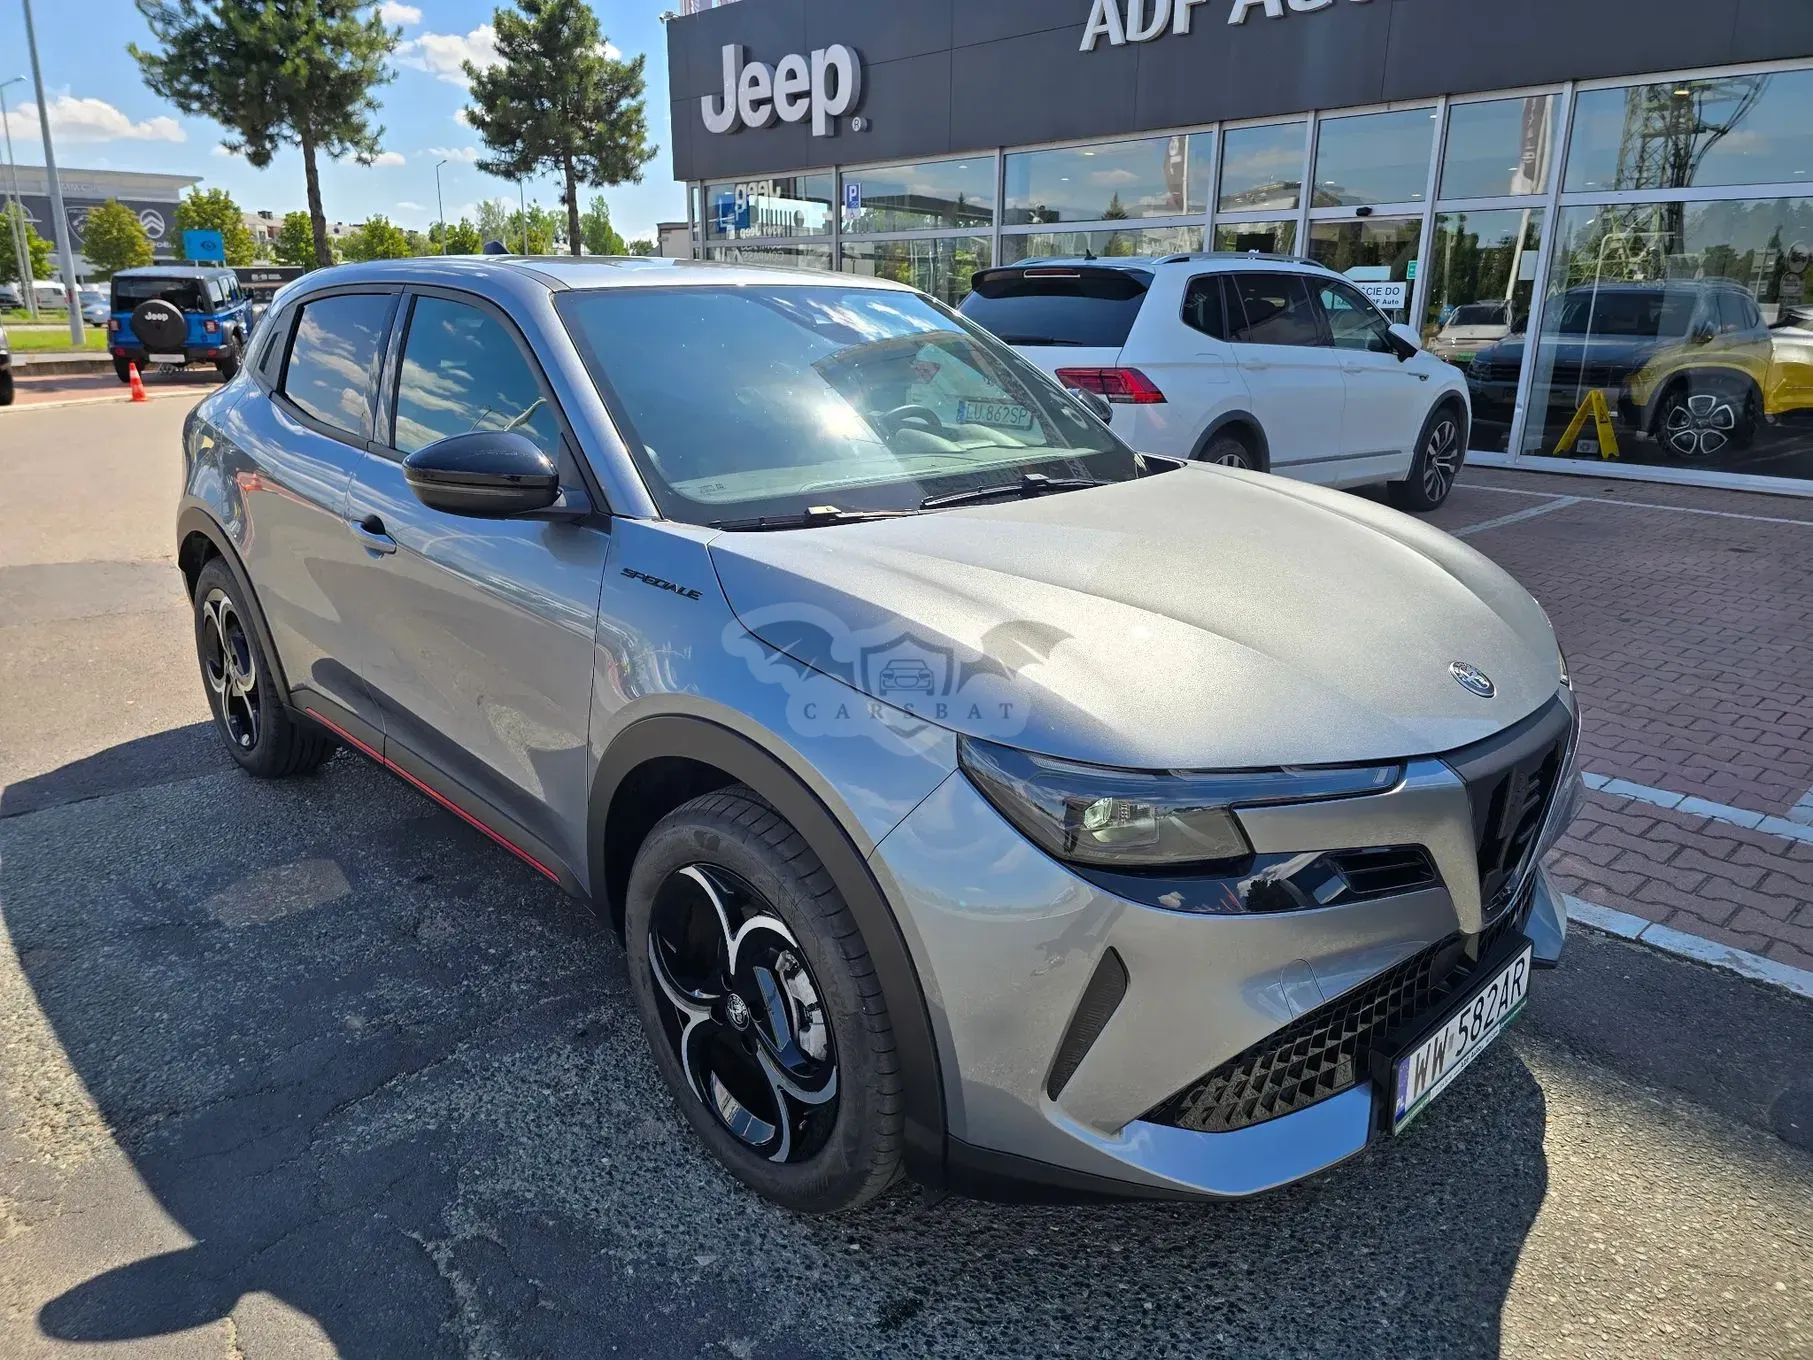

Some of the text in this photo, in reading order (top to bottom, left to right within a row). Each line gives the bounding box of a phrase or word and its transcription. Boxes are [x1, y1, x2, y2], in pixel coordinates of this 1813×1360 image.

[700, 43, 862, 137] Jeep
[849, 186, 857, 201] P
[1385, 287, 1400, 296] DO
[144, 311, 169, 322] Jeep
[620, 567, 703, 601] SPECIALE
[1414, 956, 1525, 1099] WW 582AR
